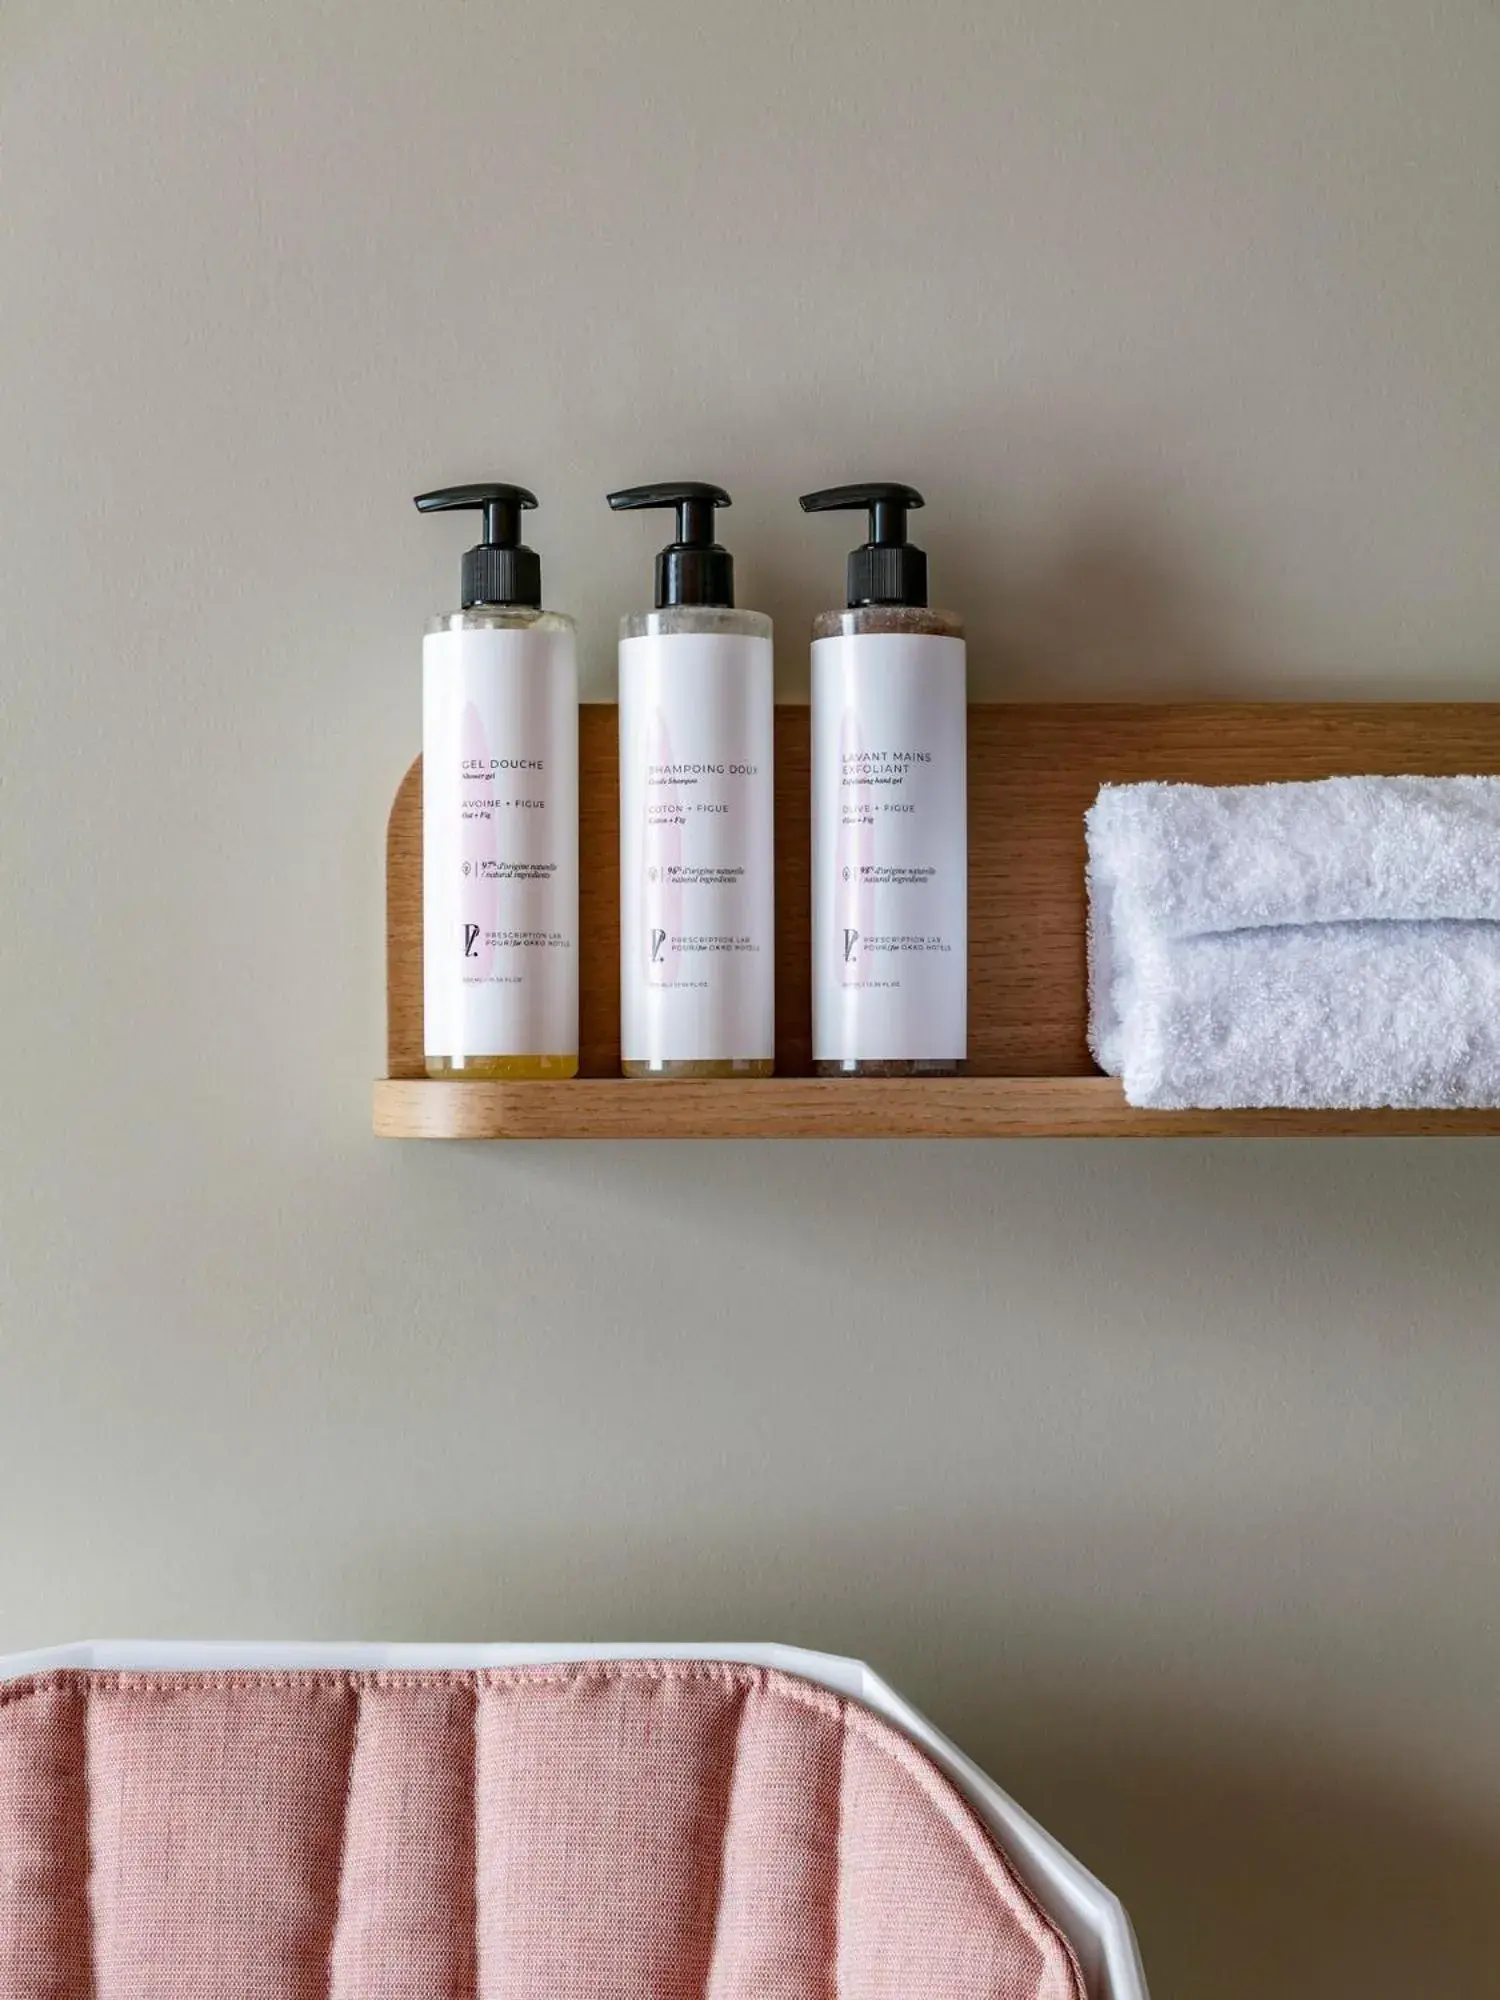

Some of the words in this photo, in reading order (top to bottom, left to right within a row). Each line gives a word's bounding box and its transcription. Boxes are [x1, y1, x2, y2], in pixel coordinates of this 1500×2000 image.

[842, 752, 888, 763] LAVANT
[893, 752, 932, 762] MAINS
[462, 759, 485, 769] GEL
[490, 759, 544, 770] DOUCHE
[648, 764, 725, 775] SHAMPOING
[729, 764, 759, 775] DOUX
[842, 764, 909, 775] EXFOLIANT
[462, 800, 501, 808] AVOINE
[515, 800, 545, 809] FIGUE
[648, 804, 683, 813] COTON
[696, 804, 730, 813] FIGUE
[884, 804, 916, 813] FIGUE
